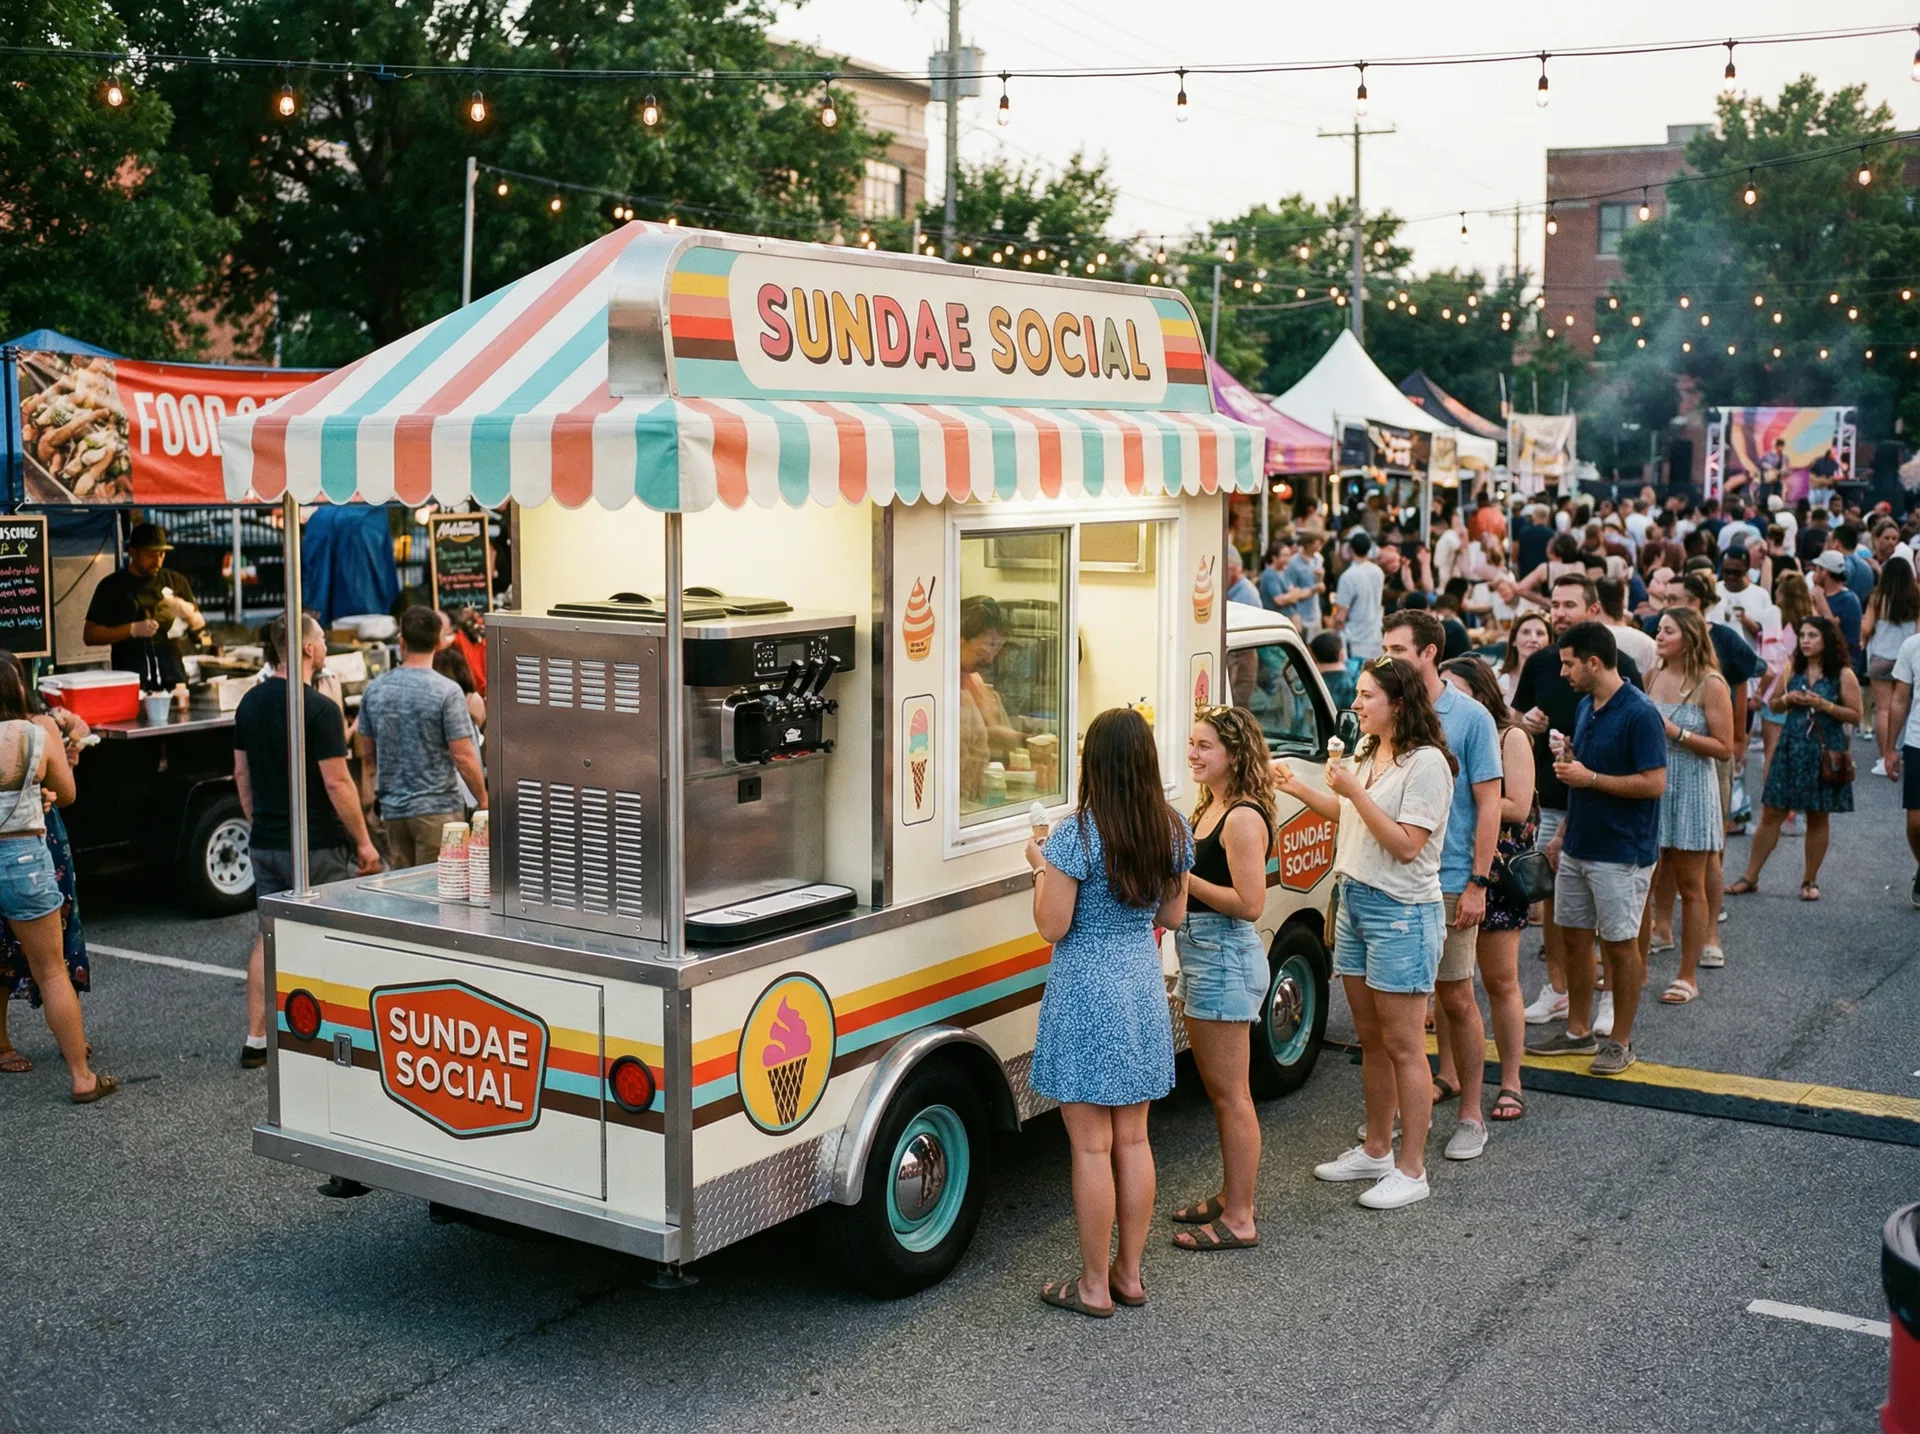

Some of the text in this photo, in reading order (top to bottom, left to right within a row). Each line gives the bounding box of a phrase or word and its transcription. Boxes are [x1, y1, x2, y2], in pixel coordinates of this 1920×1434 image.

[757, 282, 1151, 381] SUNDAE SOCIAL
[133, 392, 227, 457] FOOD
[1283, 820, 1332, 854] SUNDAE
[1285, 846, 1328, 877] SOCIAL
[388, 1006, 529, 1068] SUNDAE
[395, 1050, 524, 1112] SOCIAL
